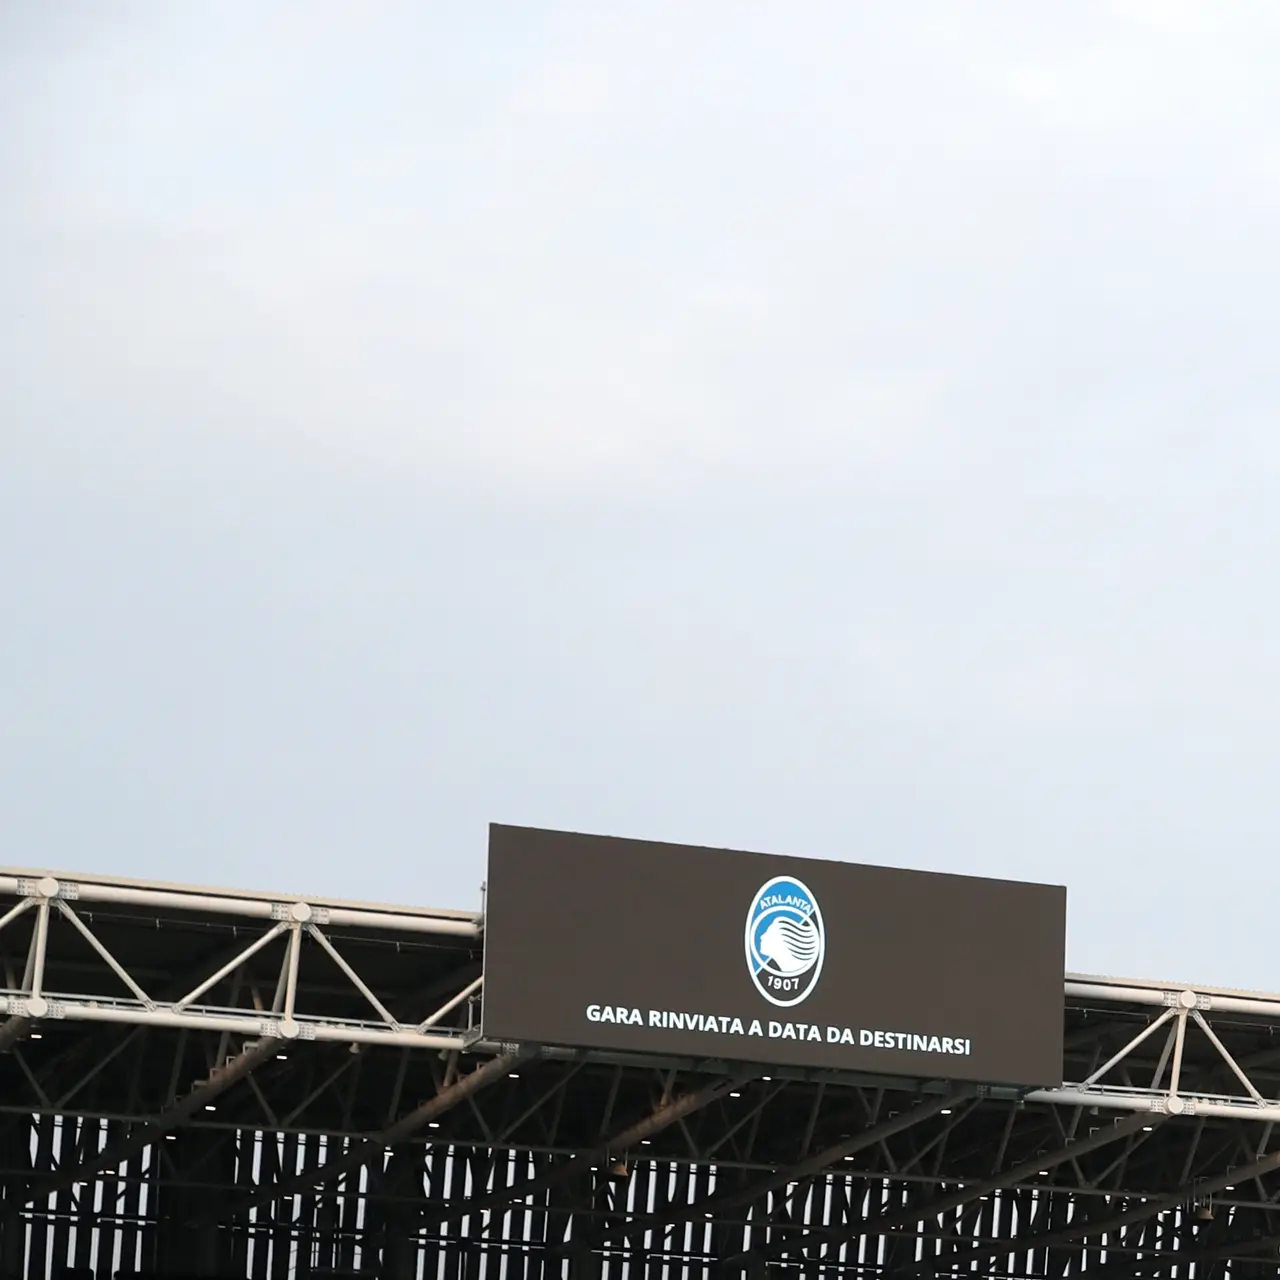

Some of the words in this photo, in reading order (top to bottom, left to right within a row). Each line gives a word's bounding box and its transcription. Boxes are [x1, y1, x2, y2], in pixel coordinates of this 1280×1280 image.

[760, 894, 812, 915] ATALANTA
[768, 975, 799, 991] 1907
[586, 1004, 643, 1026] GARA
[648, 1009, 744, 1035] RINVIATA
[748, 1019, 763, 1036] A
[768, 1021, 822, 1043] DATA
[826, 1027, 855, 1045] DA
[860, 1029, 971, 1056] DESTINARSI
